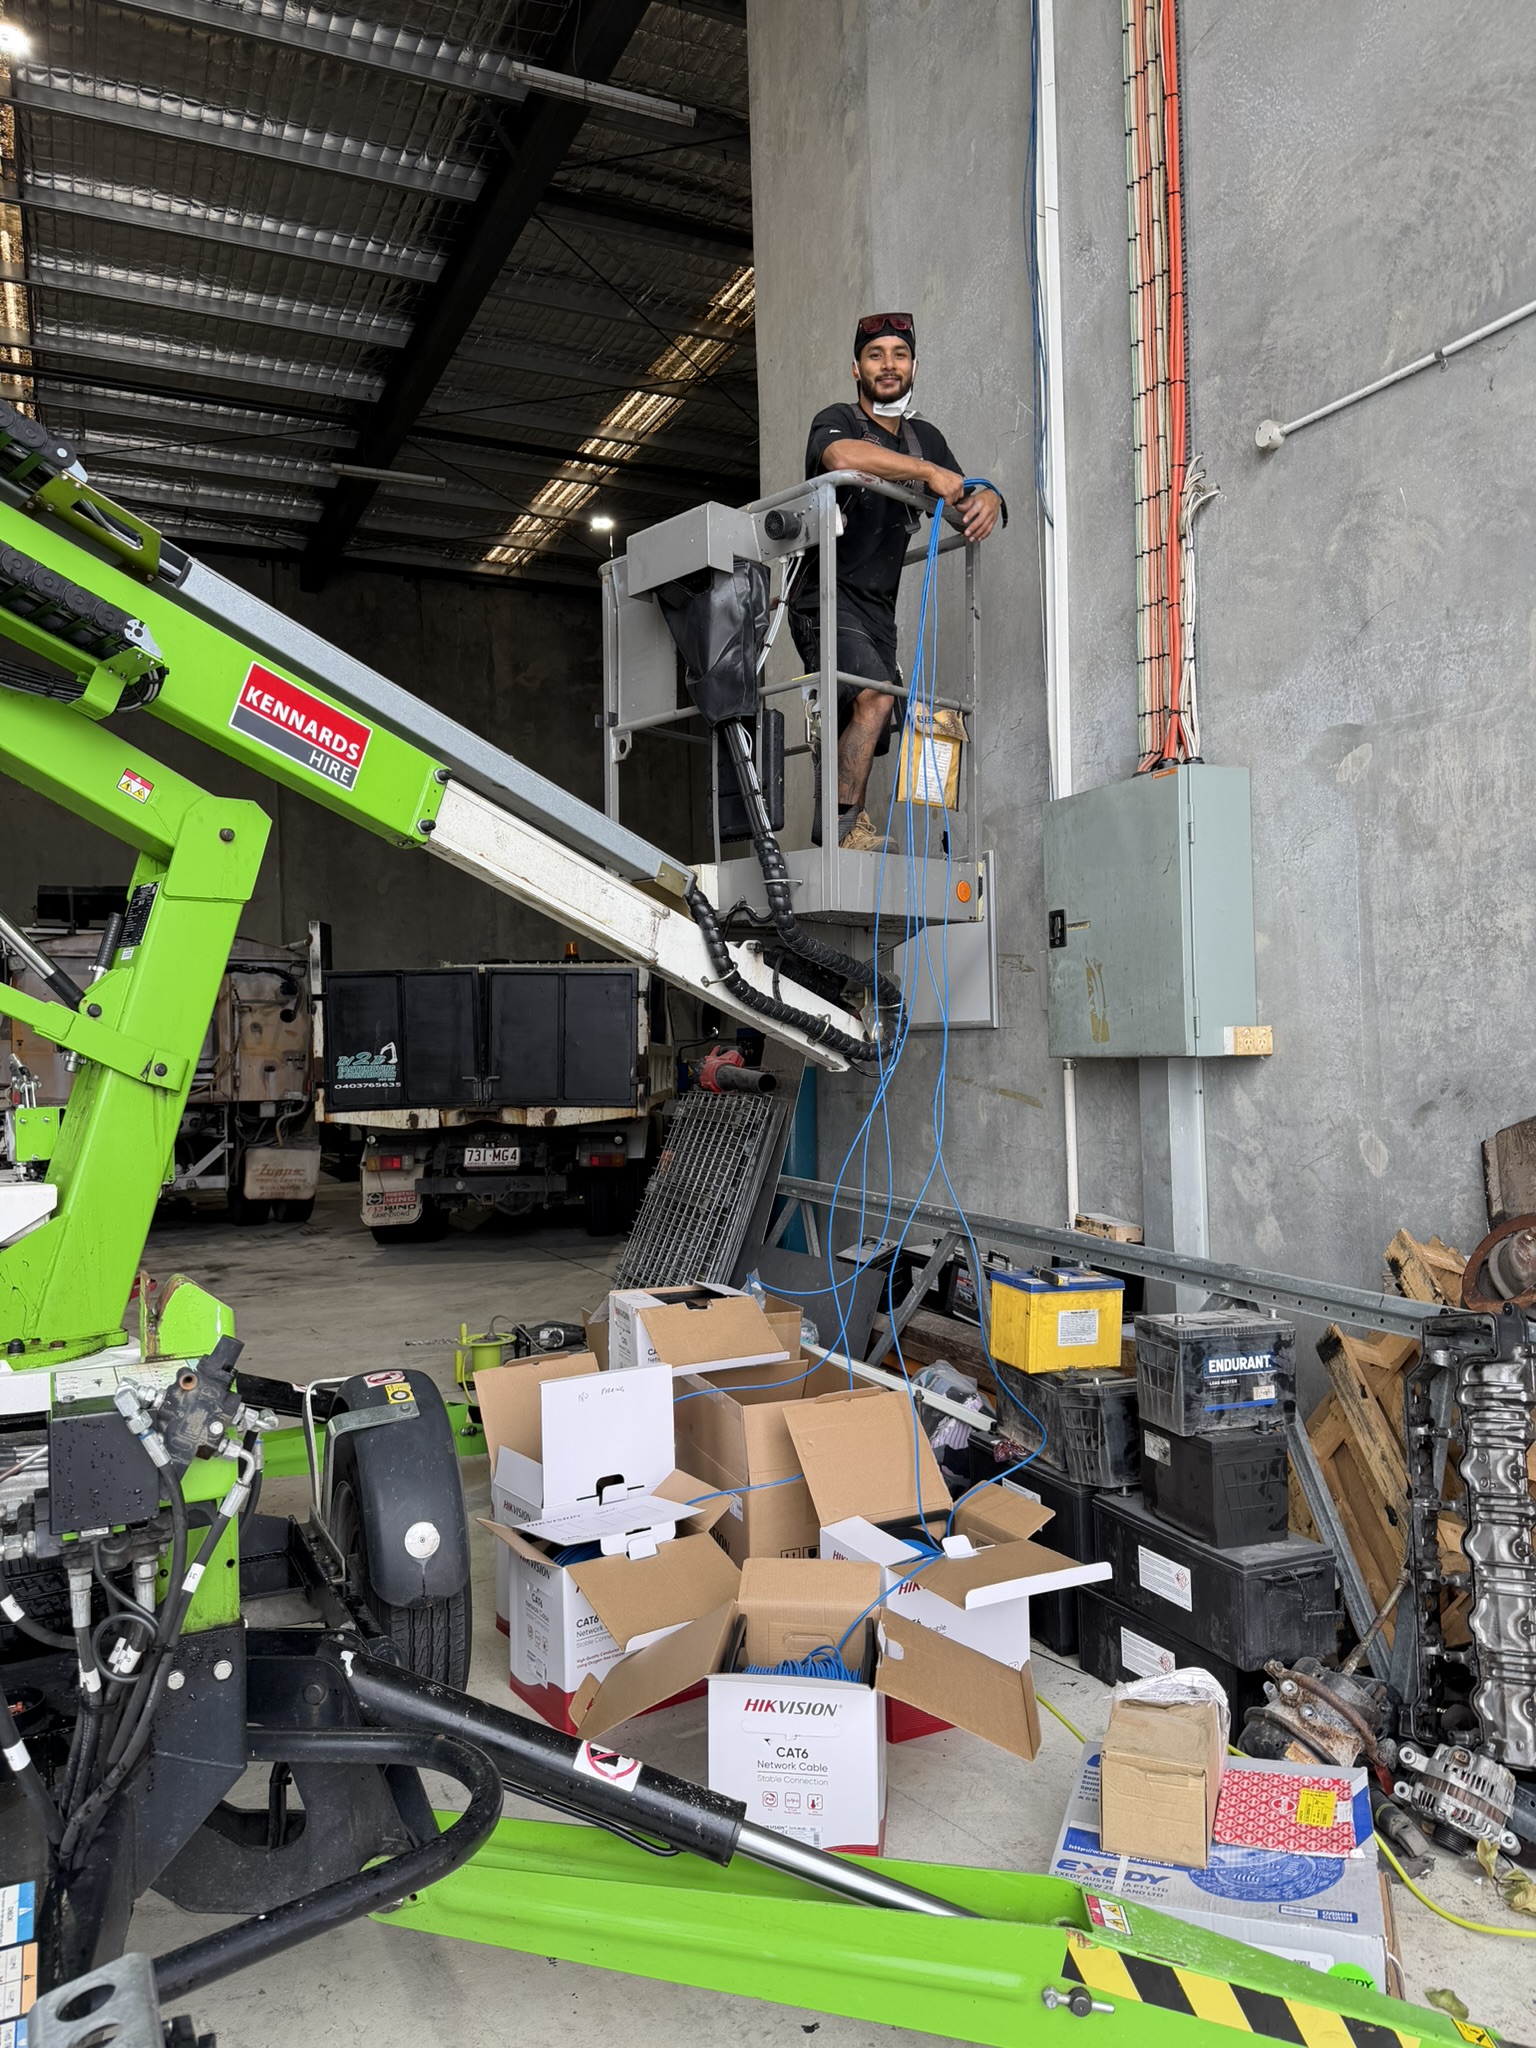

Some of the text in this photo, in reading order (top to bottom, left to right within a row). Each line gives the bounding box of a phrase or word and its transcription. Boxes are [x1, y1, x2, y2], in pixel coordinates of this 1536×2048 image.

[246, 686, 360, 760] KENNARDS
[309, 750, 352, 783] HIRE
[334, 1082, 402, 1090] 0403765635
[503, 1500, 531, 1522] HIKVISION
[576, 1615, 599, 1628] CAT6
[577, 1625, 603, 1638] Network
[744, 1698, 837, 1717] HIKVISION
[776, 1747, 809, 1759] CAT6
[757, 1760, 828, 1773] Network Cable
[757, 1774, 828, 1786] Stable Connection
[1056, 1858, 1171, 1885] EXEDY
[1054, 1870, 1081, 1880] EXEDY
[1083, 1875, 1132, 1888] AUSTRAIA
[1105, 1884, 1145, 1895] ZELAND
